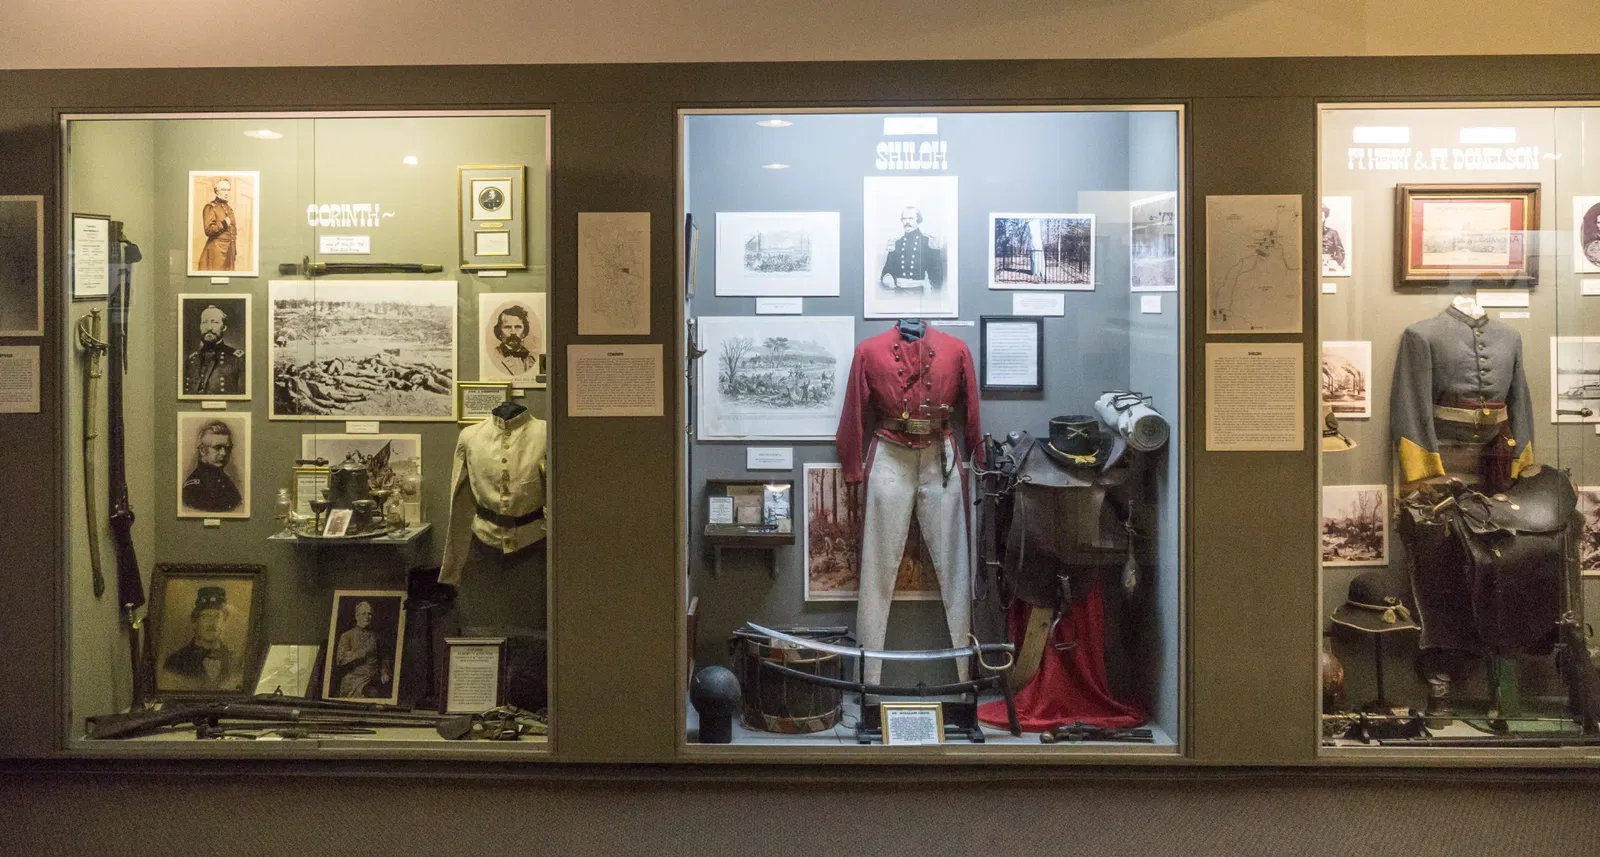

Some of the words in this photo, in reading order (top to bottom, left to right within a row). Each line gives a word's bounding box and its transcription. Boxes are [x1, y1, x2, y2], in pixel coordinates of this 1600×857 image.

[876, 141, 948, 170] SHILOH
[1367, 147, 1412, 170] HENRY
[1413, 151, 1429, 171] &
[1452, 146, 1540, 170] DONELSON
[306, 203, 380, 227] CORINTH
